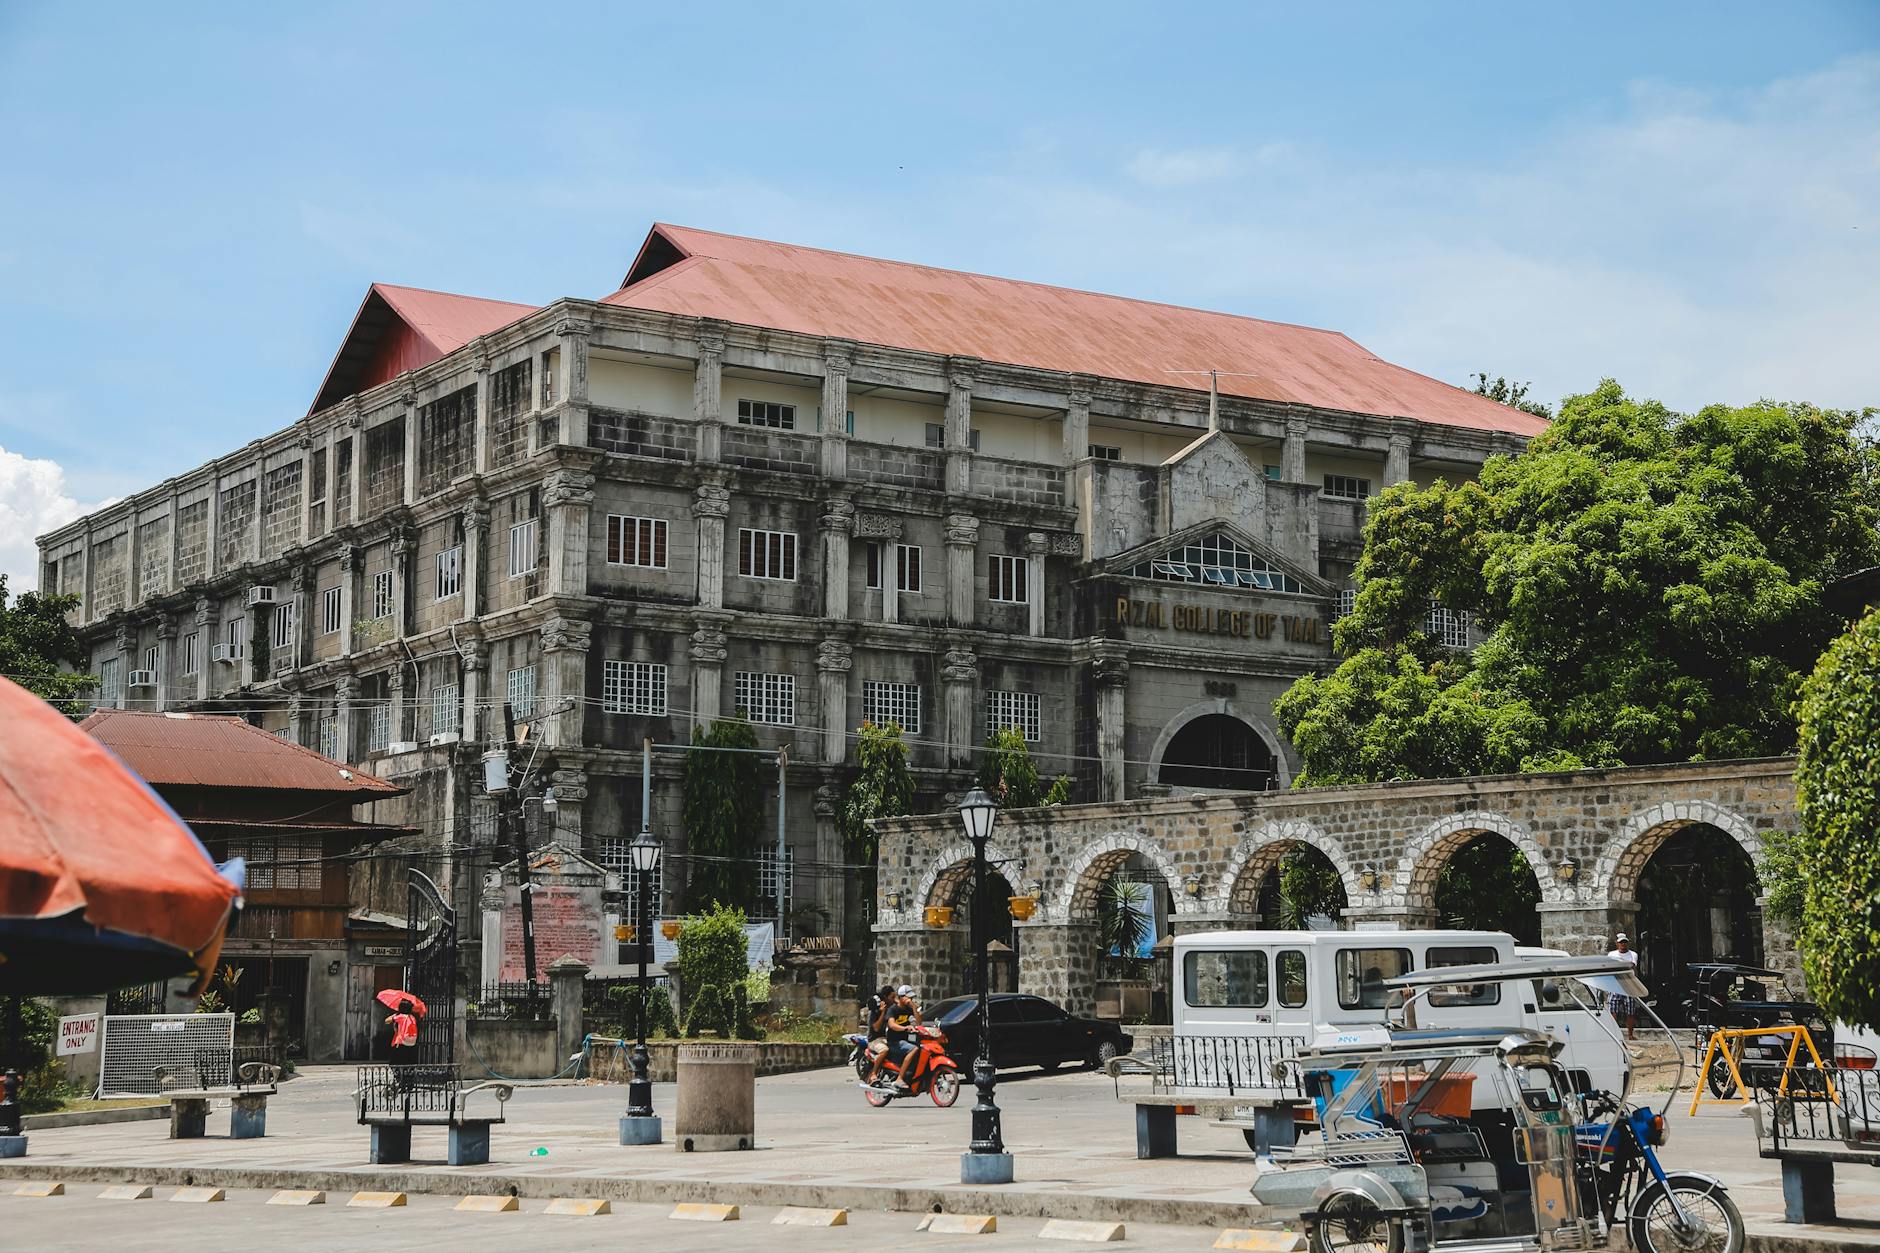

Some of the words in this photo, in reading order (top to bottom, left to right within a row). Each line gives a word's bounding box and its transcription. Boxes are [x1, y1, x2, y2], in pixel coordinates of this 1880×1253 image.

[1117, 597, 1168, 629] RIZAL
[1173, 604, 1250, 637] COLLEGE
[1255, 612, 1277, 639] OF
[1281, 615, 1325, 644] TAAL
[63, 1019, 96, 1036] ENTRANCE
[66, 1037, 87, 1048] ONLY
